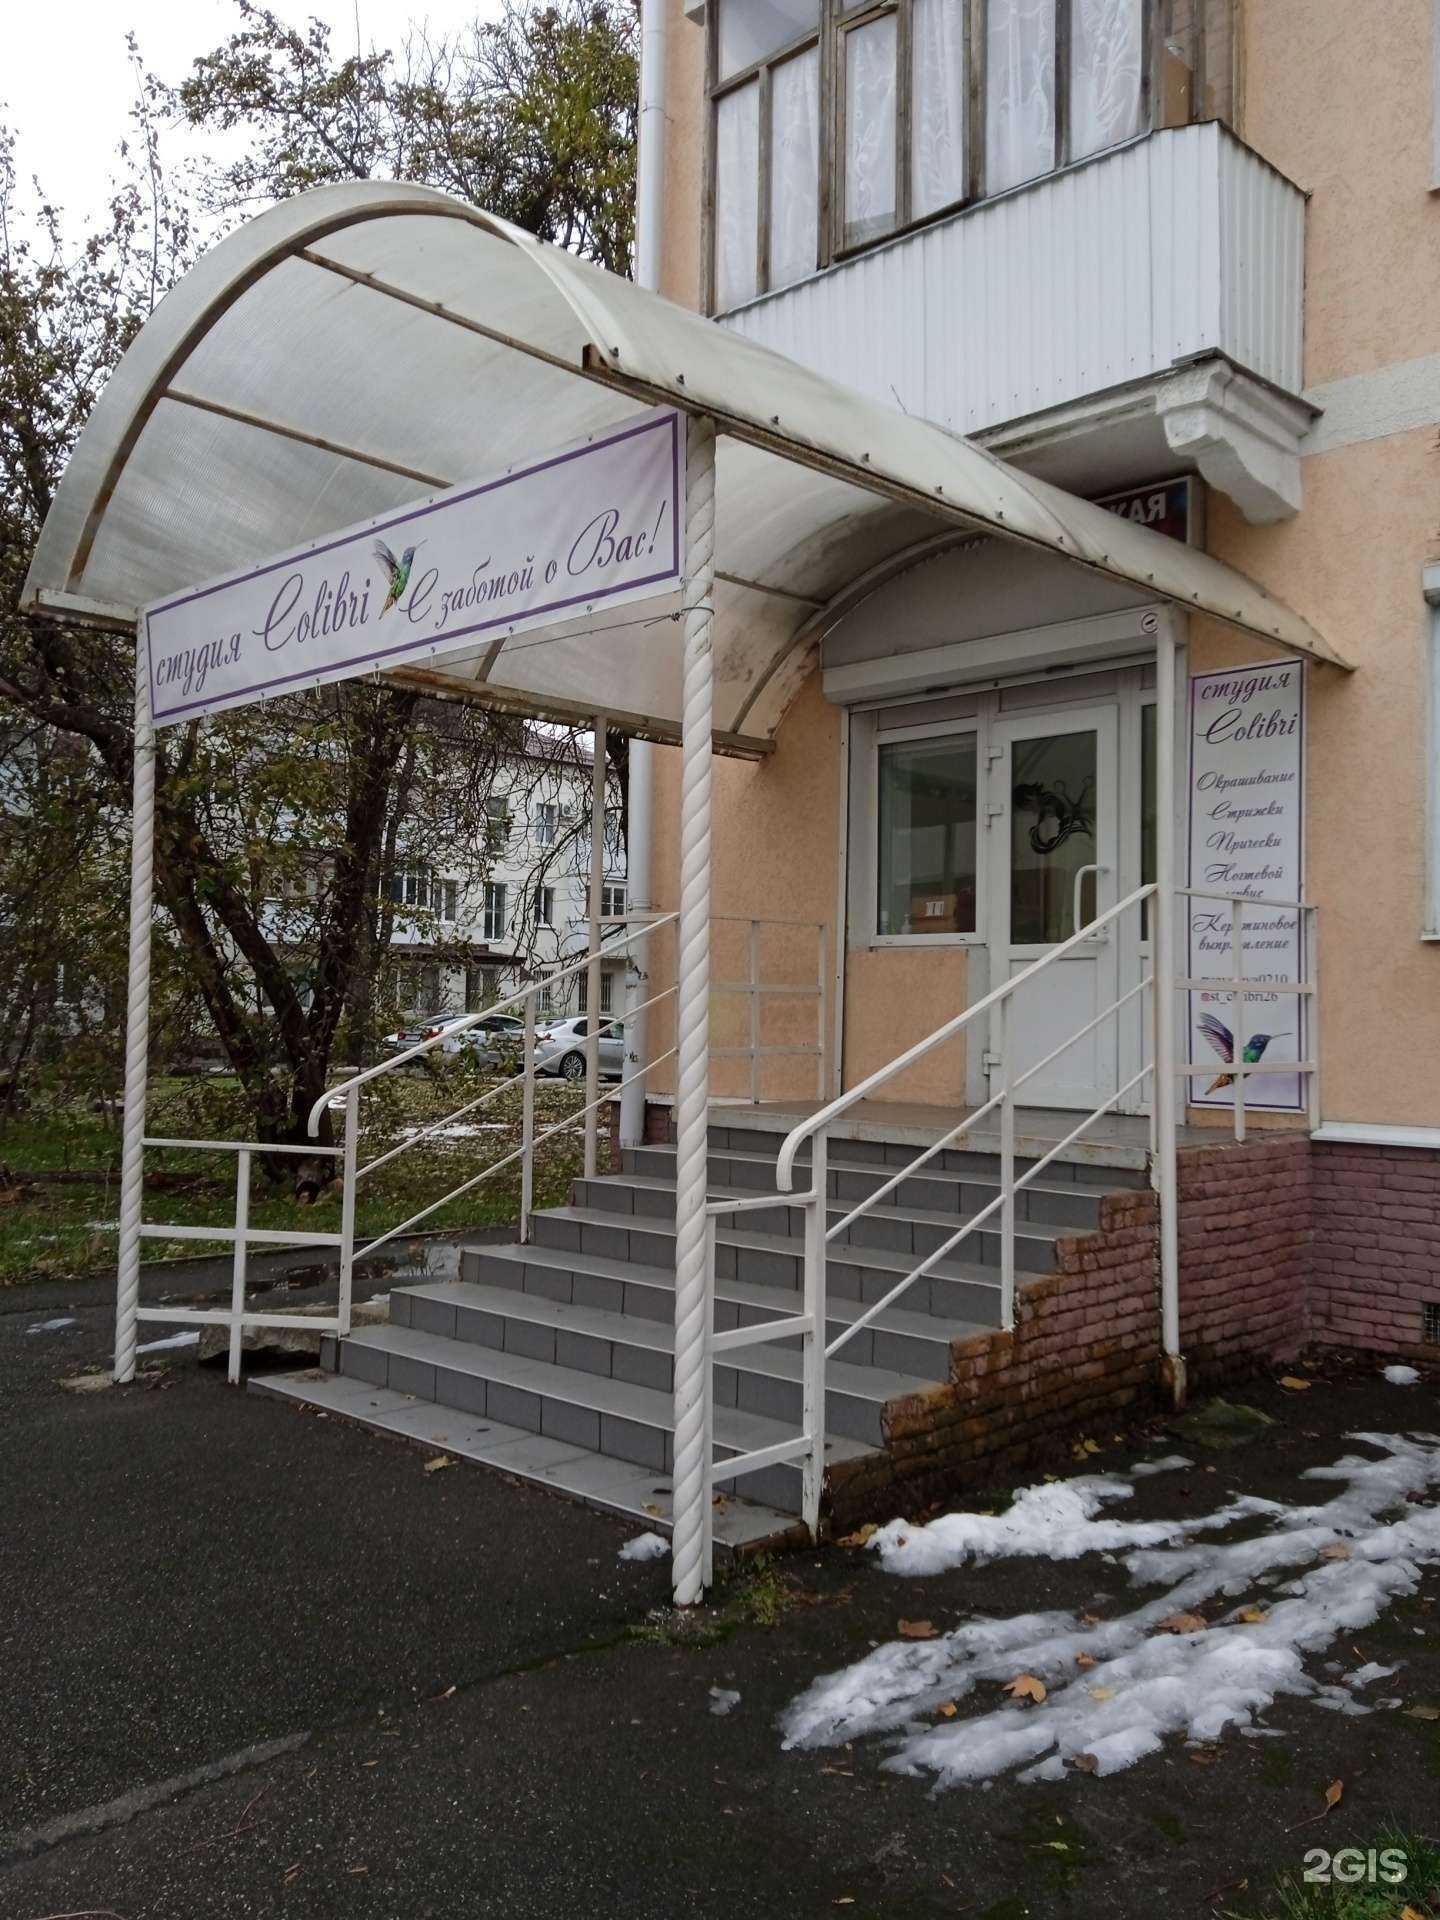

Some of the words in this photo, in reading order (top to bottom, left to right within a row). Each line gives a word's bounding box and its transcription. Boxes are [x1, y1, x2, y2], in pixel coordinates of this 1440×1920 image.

[156, 632, 242, 697] студия
[252, 571, 370, 651] Colibri
[434, 555, 535, 630] заботой
[544, 559, 558, 585] о
[567, 500, 667, 576] Вас!
[1200, 672, 1291, 704] студия
[1195, 708, 1298, 745] Colibri
[1196, 769, 1295, 793] Окрашивание
[1207, 800, 1284, 823] Стрижки
[1206, 831, 1283, 855] Прически
[1204, 863, 1283, 883] Ногтевой
[1192, 912, 1297, 937] Кертиновое
[1198, 935, 1289, 955] выпрмление
